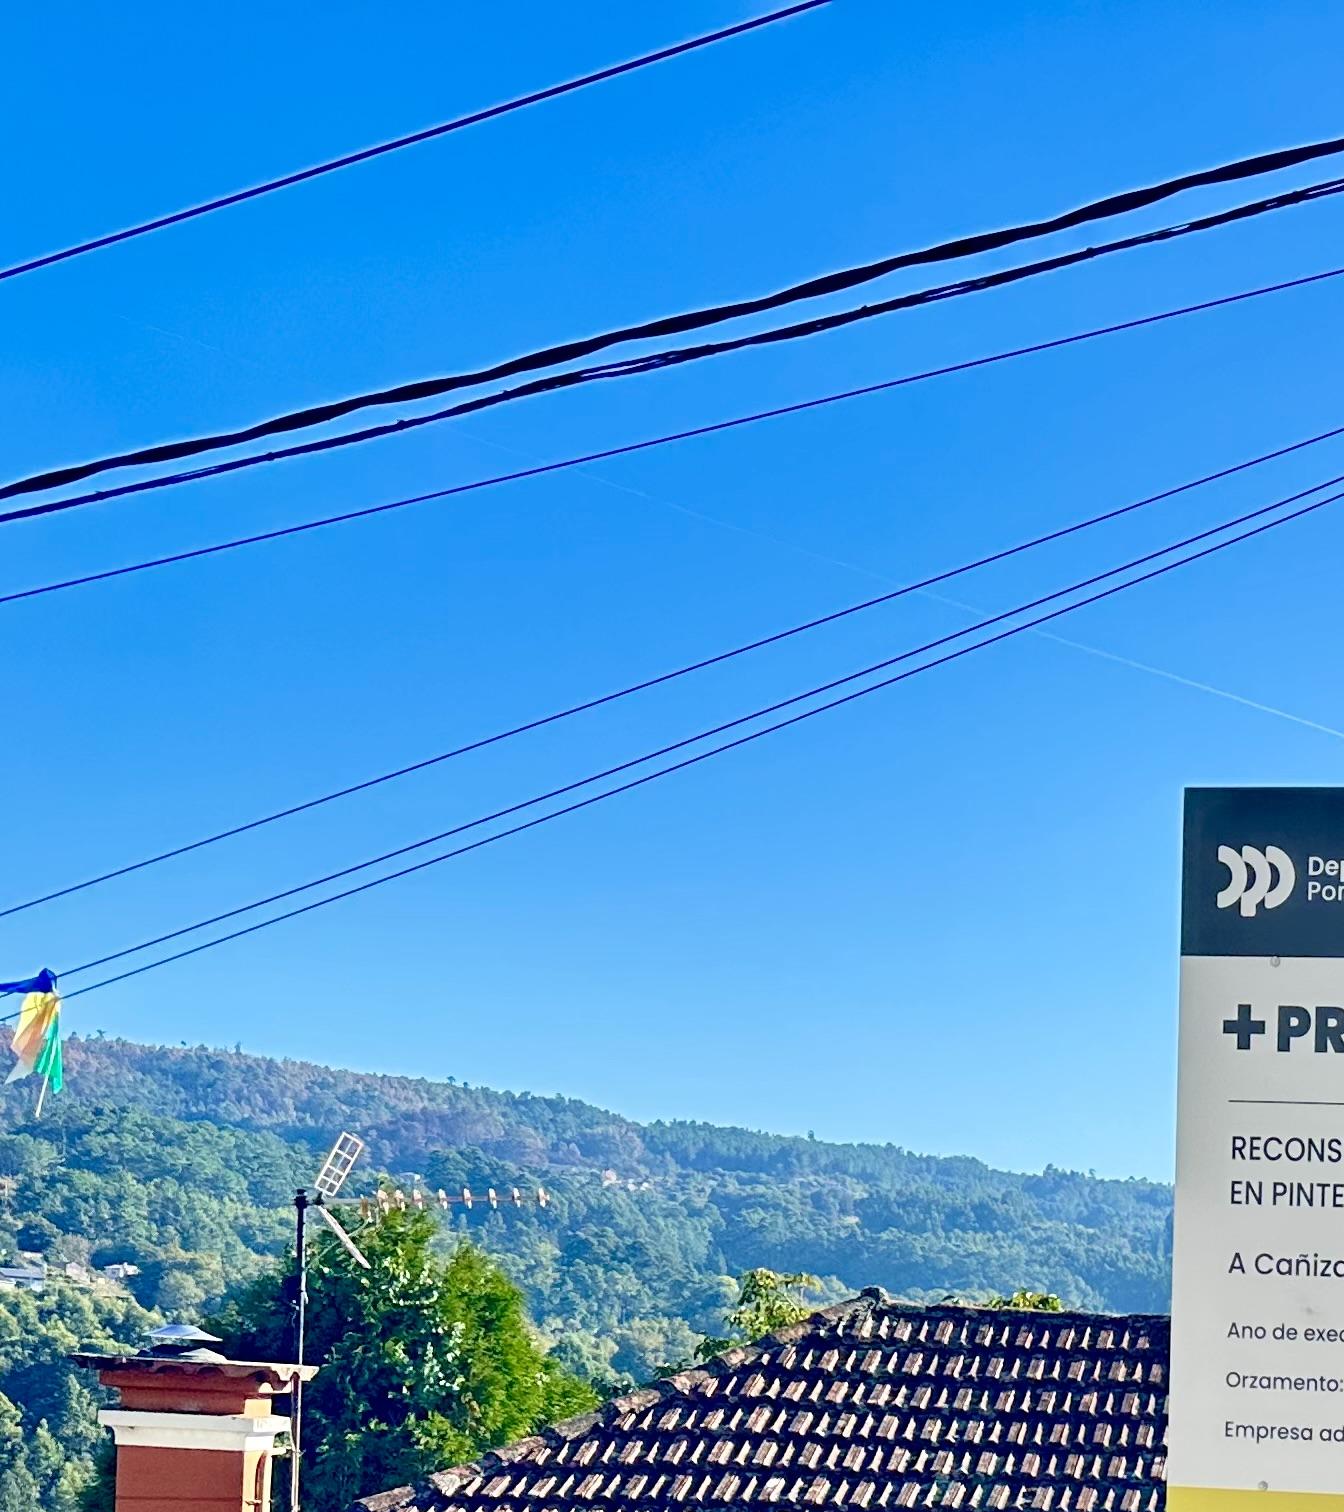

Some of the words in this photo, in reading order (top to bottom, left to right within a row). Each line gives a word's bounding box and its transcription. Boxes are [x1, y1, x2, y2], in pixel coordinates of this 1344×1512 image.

[1230, 1180, 1263, 1206] EN
[1228, 1252, 1246, 1275] A
[1227, 1321, 1267, 1340] Ano
[1272, 1323, 1298, 1341] de
[1225, 1371, 1344, 1393] Orzamento:
[1224, 1420, 1313, 1444] Empresa
